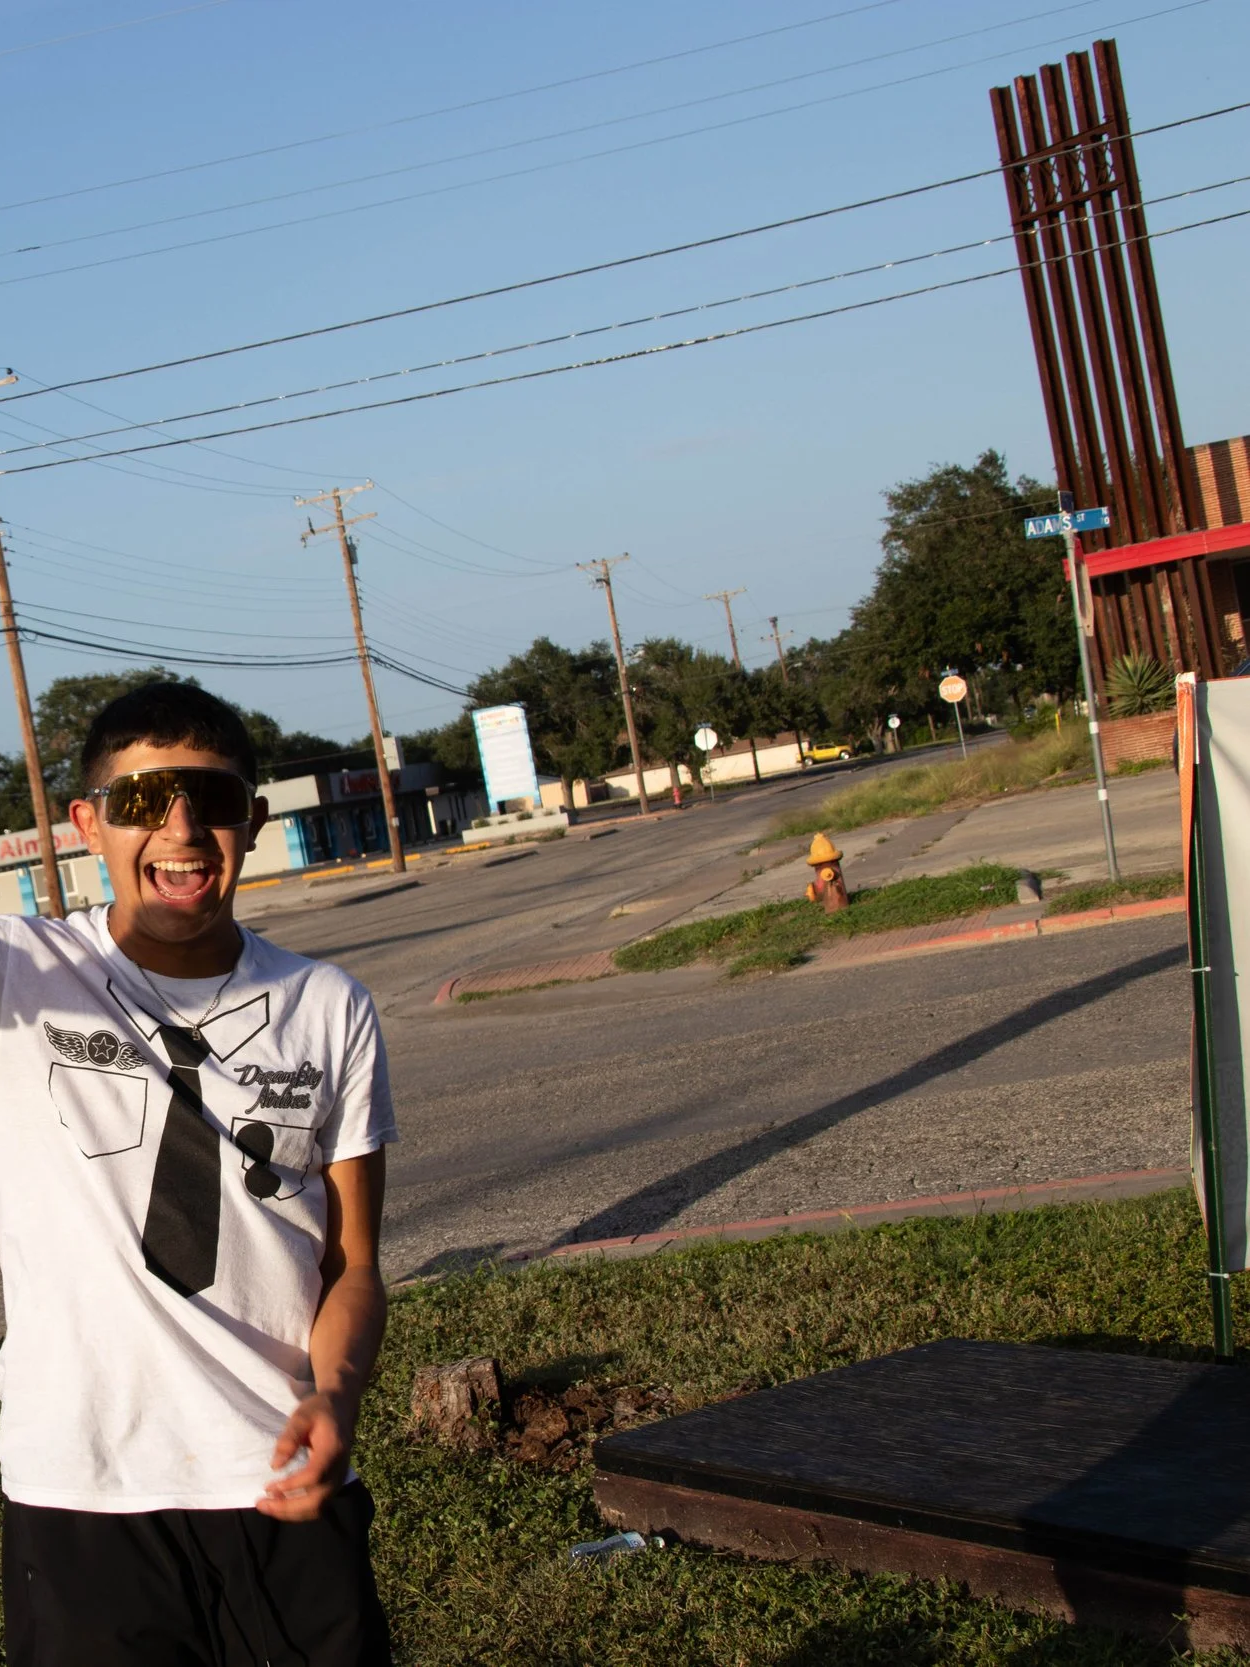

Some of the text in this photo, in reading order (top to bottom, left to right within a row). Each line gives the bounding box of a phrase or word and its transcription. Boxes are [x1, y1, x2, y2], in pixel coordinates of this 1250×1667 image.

[1026, 515, 1072, 536] ADAMS
[1076, 513, 1085, 522] ST
[940, 682, 965, 696] STOP
